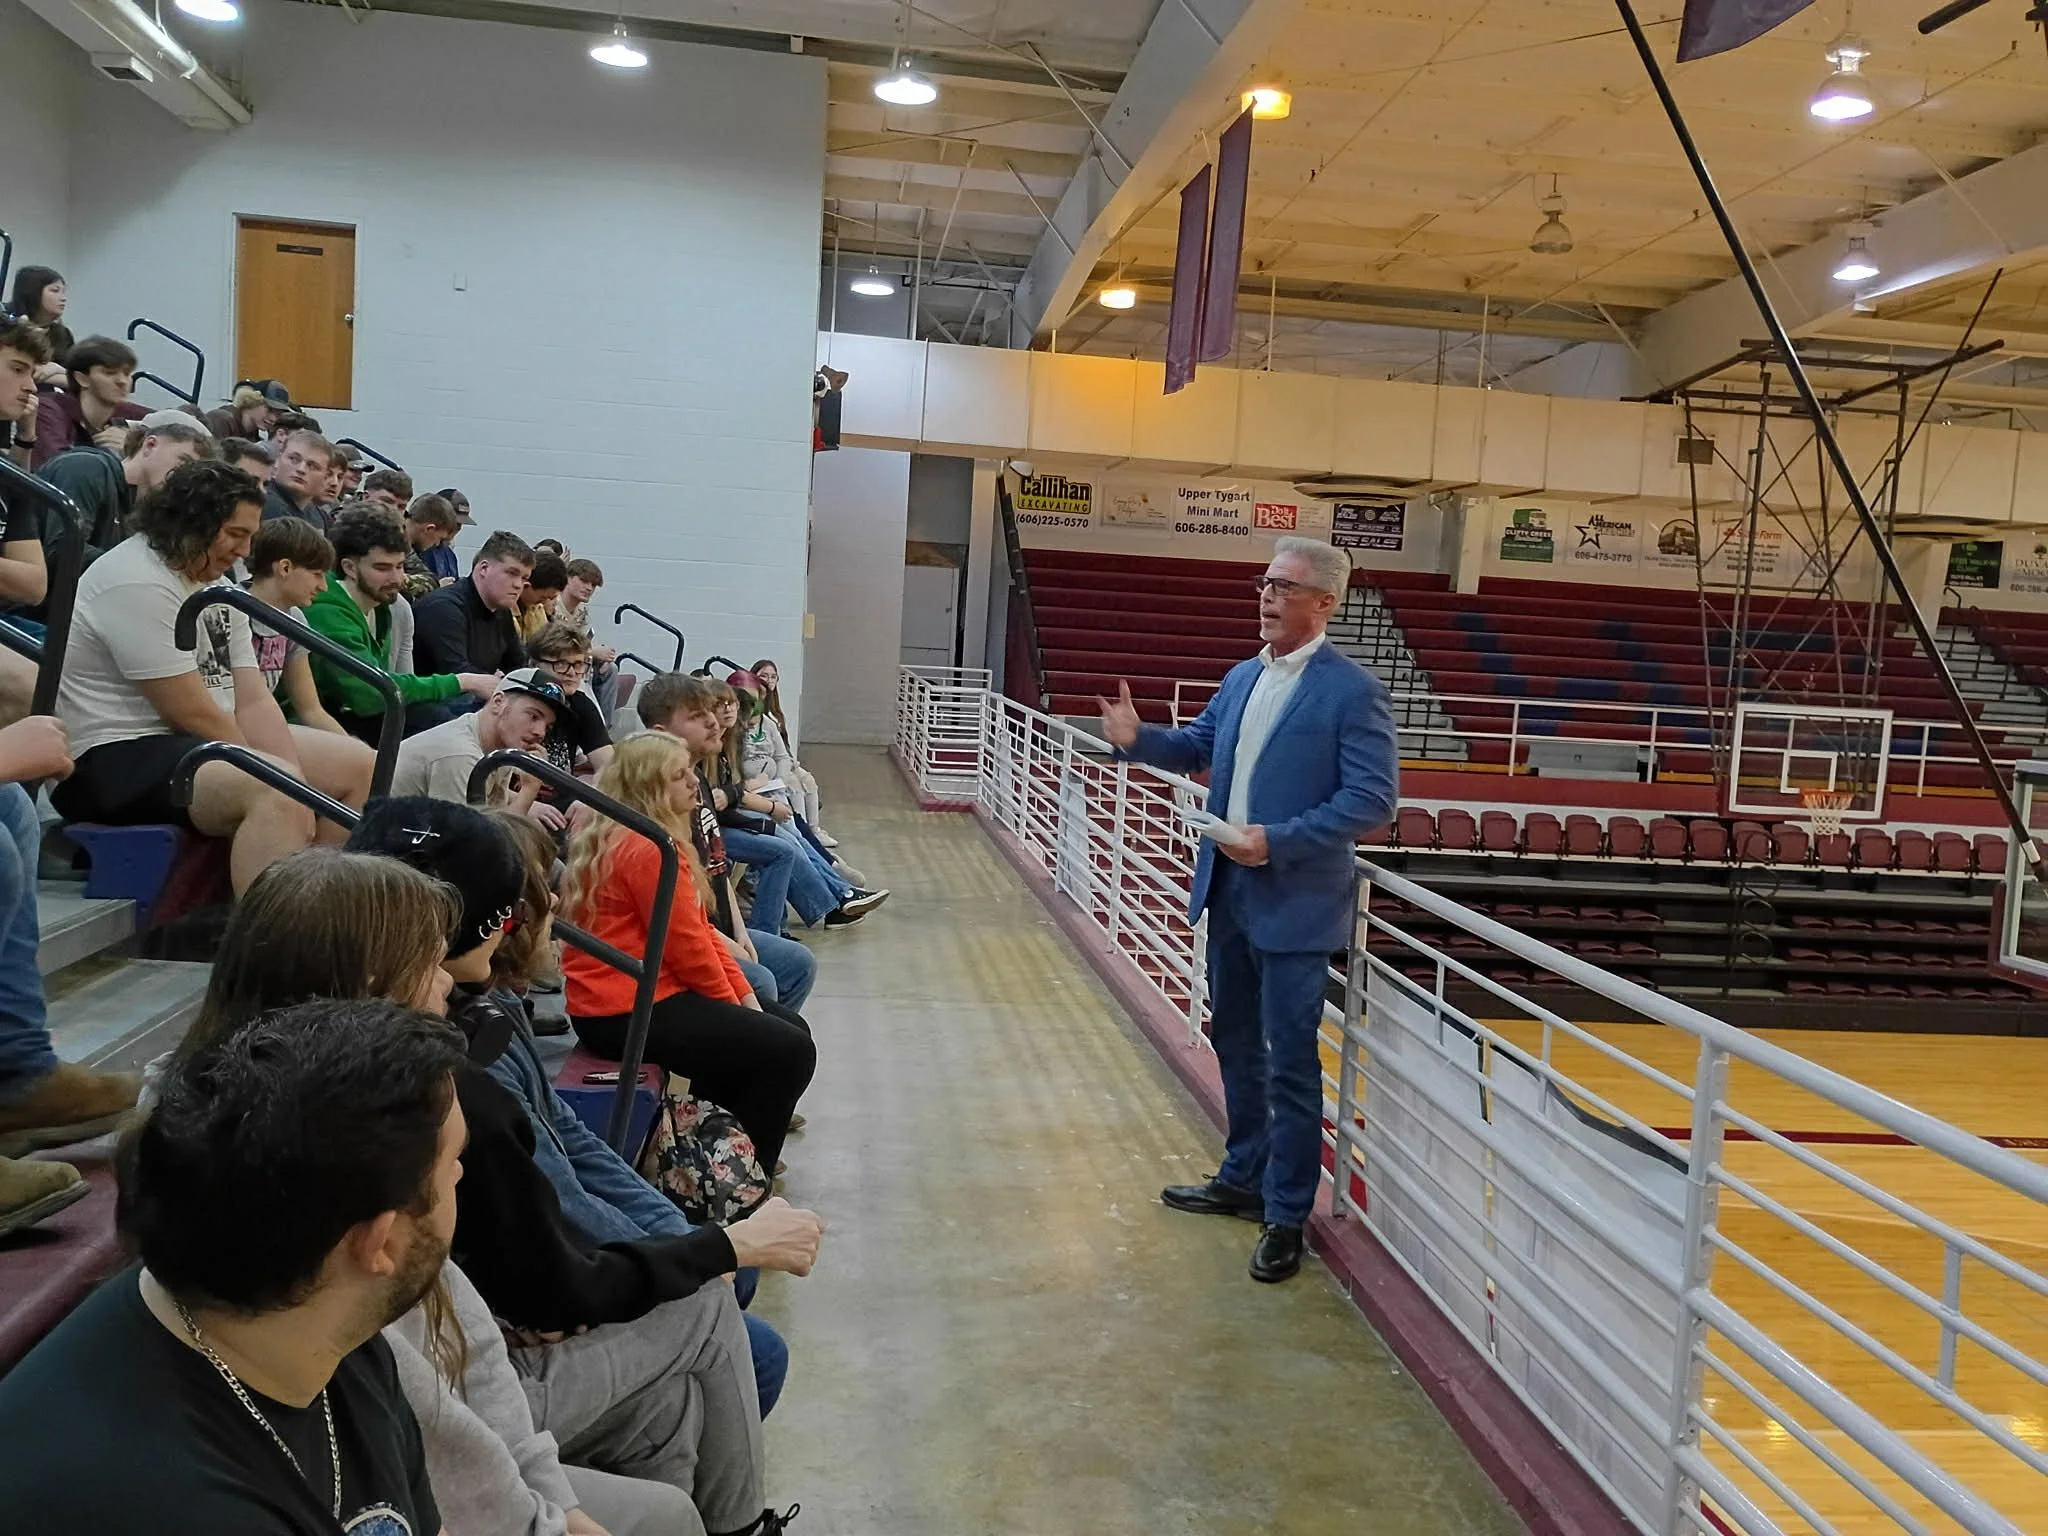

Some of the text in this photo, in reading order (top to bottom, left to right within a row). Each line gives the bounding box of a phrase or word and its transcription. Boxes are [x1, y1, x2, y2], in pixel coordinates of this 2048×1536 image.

[1020, 477, 1090, 500] Callihan
[1178, 488, 1250, 503] Upper Tygart
[1021, 499, 1088, 512] EXCAVATING
[1187, 505, 1239, 518] Mini Mart
[1016, 514, 1089, 528] (606)225-0570
[1256, 507, 1295, 529] Best
[1175, 522, 1249, 535] 606-286-8400
